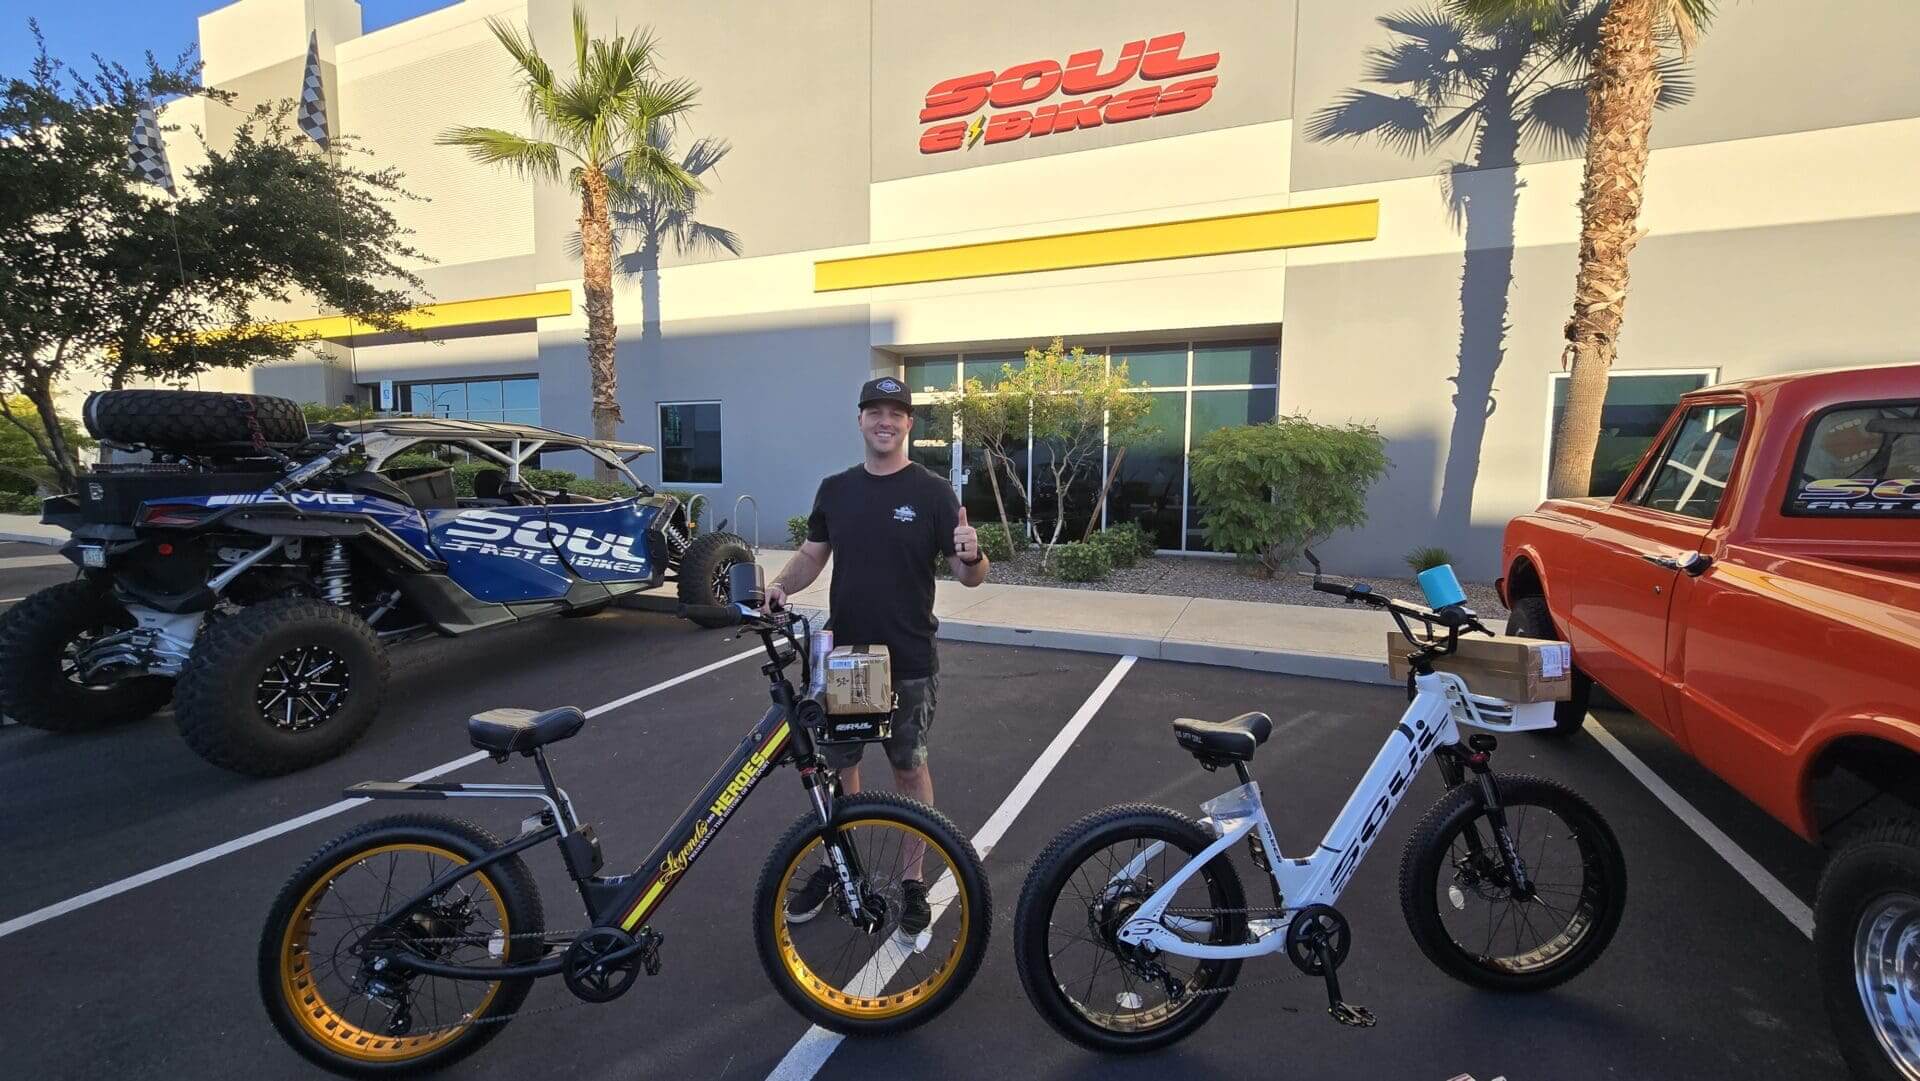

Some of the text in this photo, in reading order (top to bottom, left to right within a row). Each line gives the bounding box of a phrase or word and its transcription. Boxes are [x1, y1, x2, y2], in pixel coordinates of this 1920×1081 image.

[918, 31, 1220, 124] SOUL
[983, 74, 1219, 147] BIKES
[255, 493, 356, 505] AMG
[1806, 501, 1902, 510] FAST
[439, 538, 542, 560] FAST
[575, 556, 642, 574] BIKES
[446, 509, 646, 563] SOUL
[660, 818, 709, 885] Legends
[709, 751, 766, 817] HEROES
[1329, 712, 1449, 896] SOUL
[830, 845, 861, 919] SOUL
